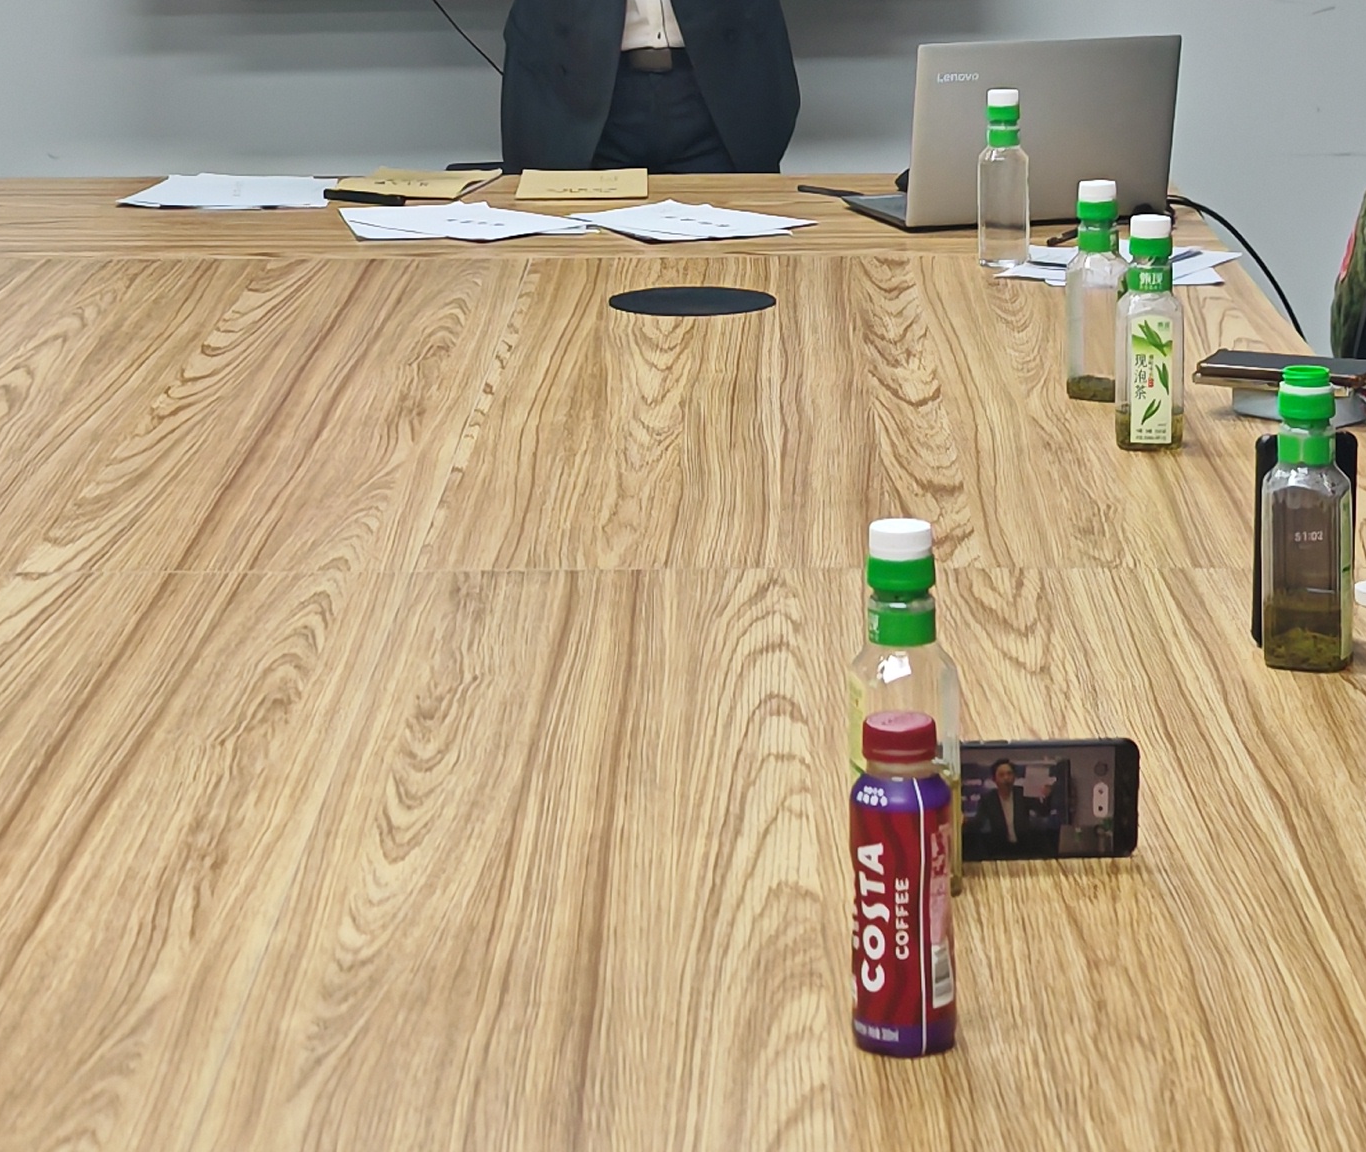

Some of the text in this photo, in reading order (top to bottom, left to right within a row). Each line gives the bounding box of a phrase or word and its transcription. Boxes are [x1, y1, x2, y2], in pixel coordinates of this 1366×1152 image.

[937, 72, 980, 84] Lenovo
[1134, 353, 1148, 401] 现泡茶
[857, 842, 891, 993] COSTA
[894, 876, 910, 961] COFFEE
